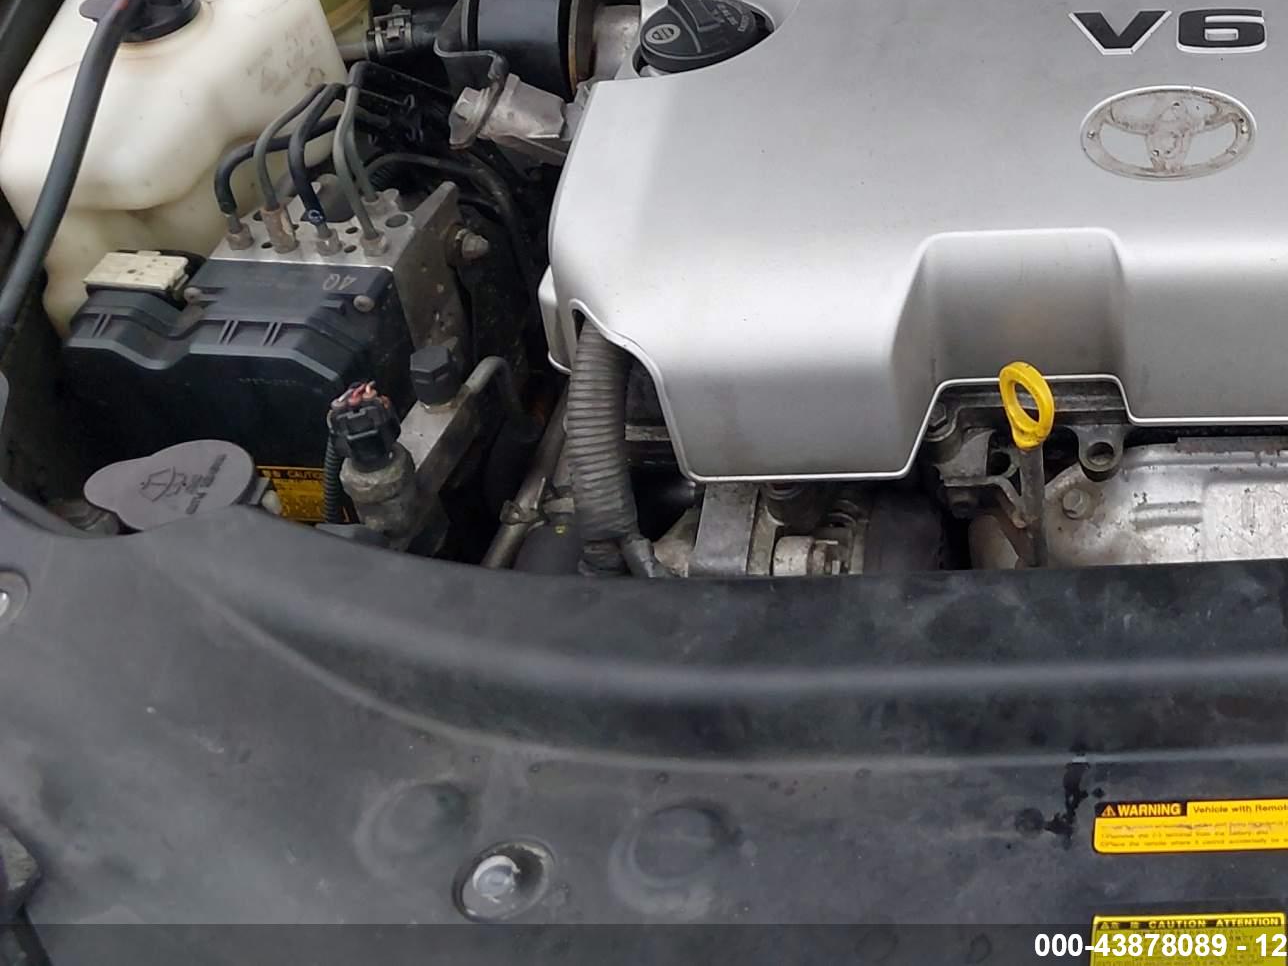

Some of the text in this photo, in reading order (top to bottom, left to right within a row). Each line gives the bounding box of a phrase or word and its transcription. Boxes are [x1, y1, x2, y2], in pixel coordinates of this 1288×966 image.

[1068, 8, 1267, 55] V6
[1117, 803, 1181, 817] WARNING
[1193, 805, 1228, 814] Vehicle
[1231, 803, 1252, 813] with
[1148, 920, 1206, 929] CAUTION
[1216, 917, 1278, 927] ATTENTION
